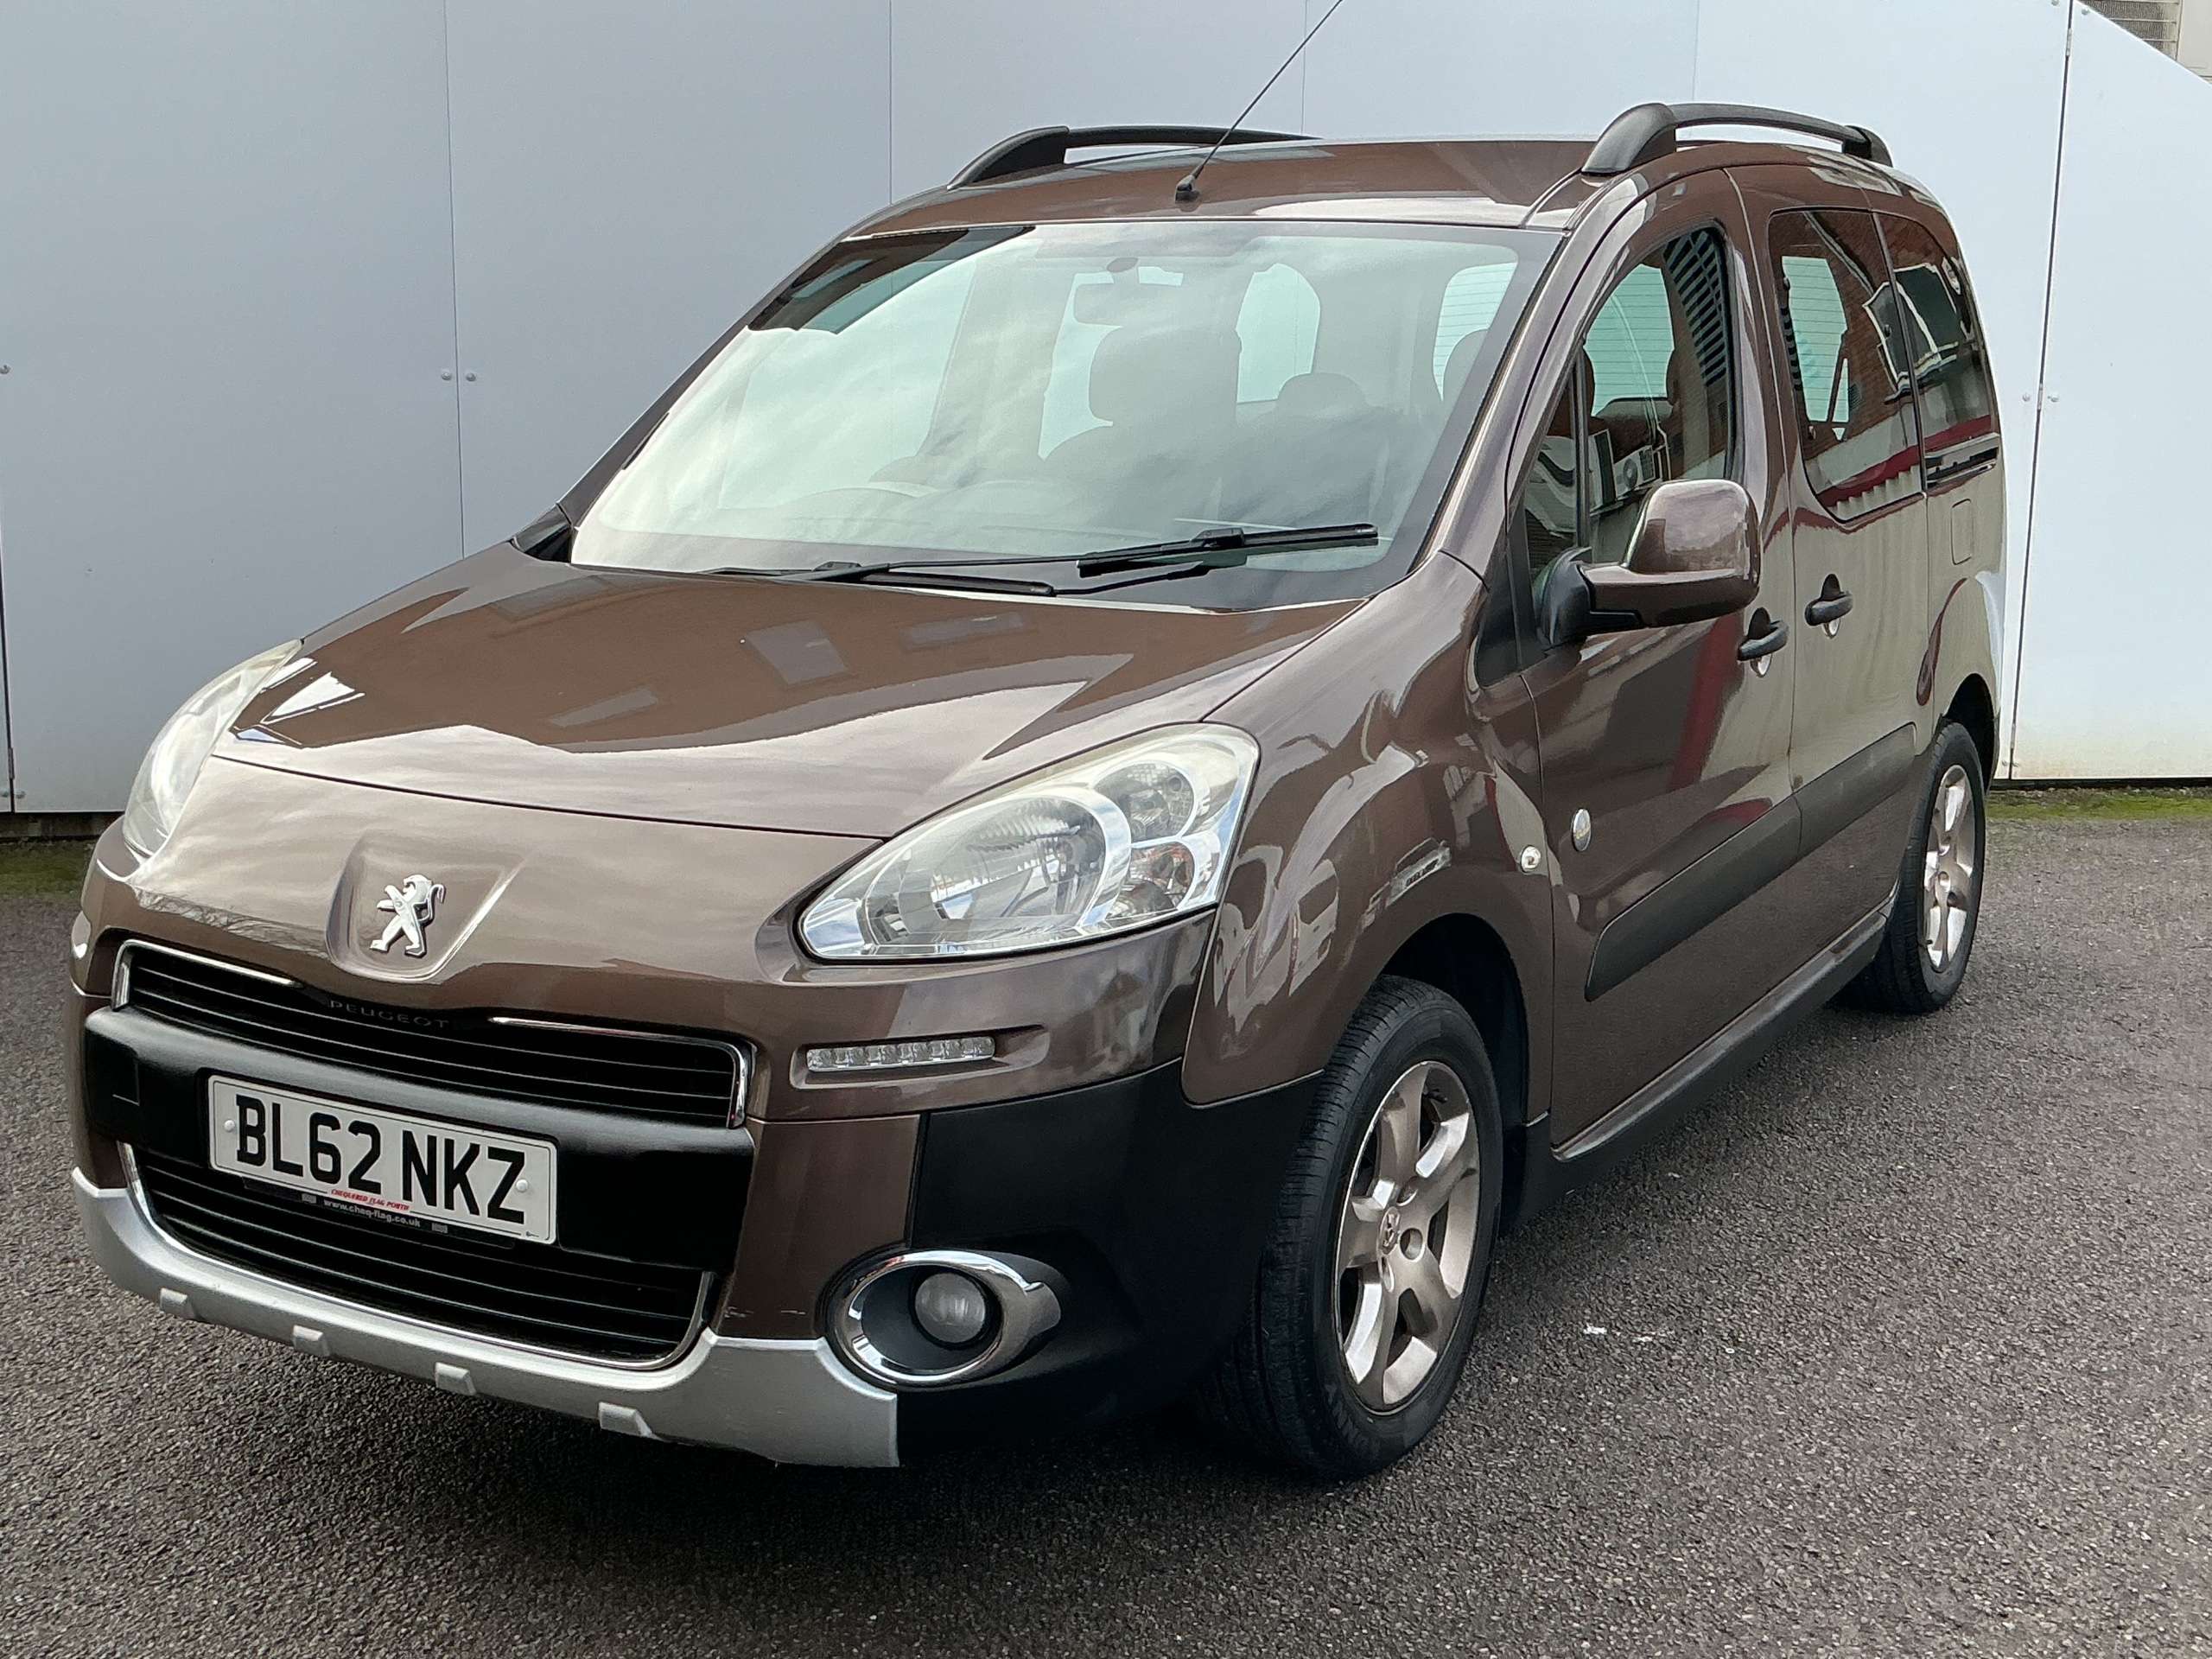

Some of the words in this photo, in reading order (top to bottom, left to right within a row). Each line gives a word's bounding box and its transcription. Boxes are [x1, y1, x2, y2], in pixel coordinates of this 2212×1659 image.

[329, 1000, 449, 1028] PEUGEOT
[236, 1094, 381, 1194] BL62
[402, 1129, 525, 1224] NKZ
[323, 1199, 421, 1227] www.cheq-flag.co.uk
